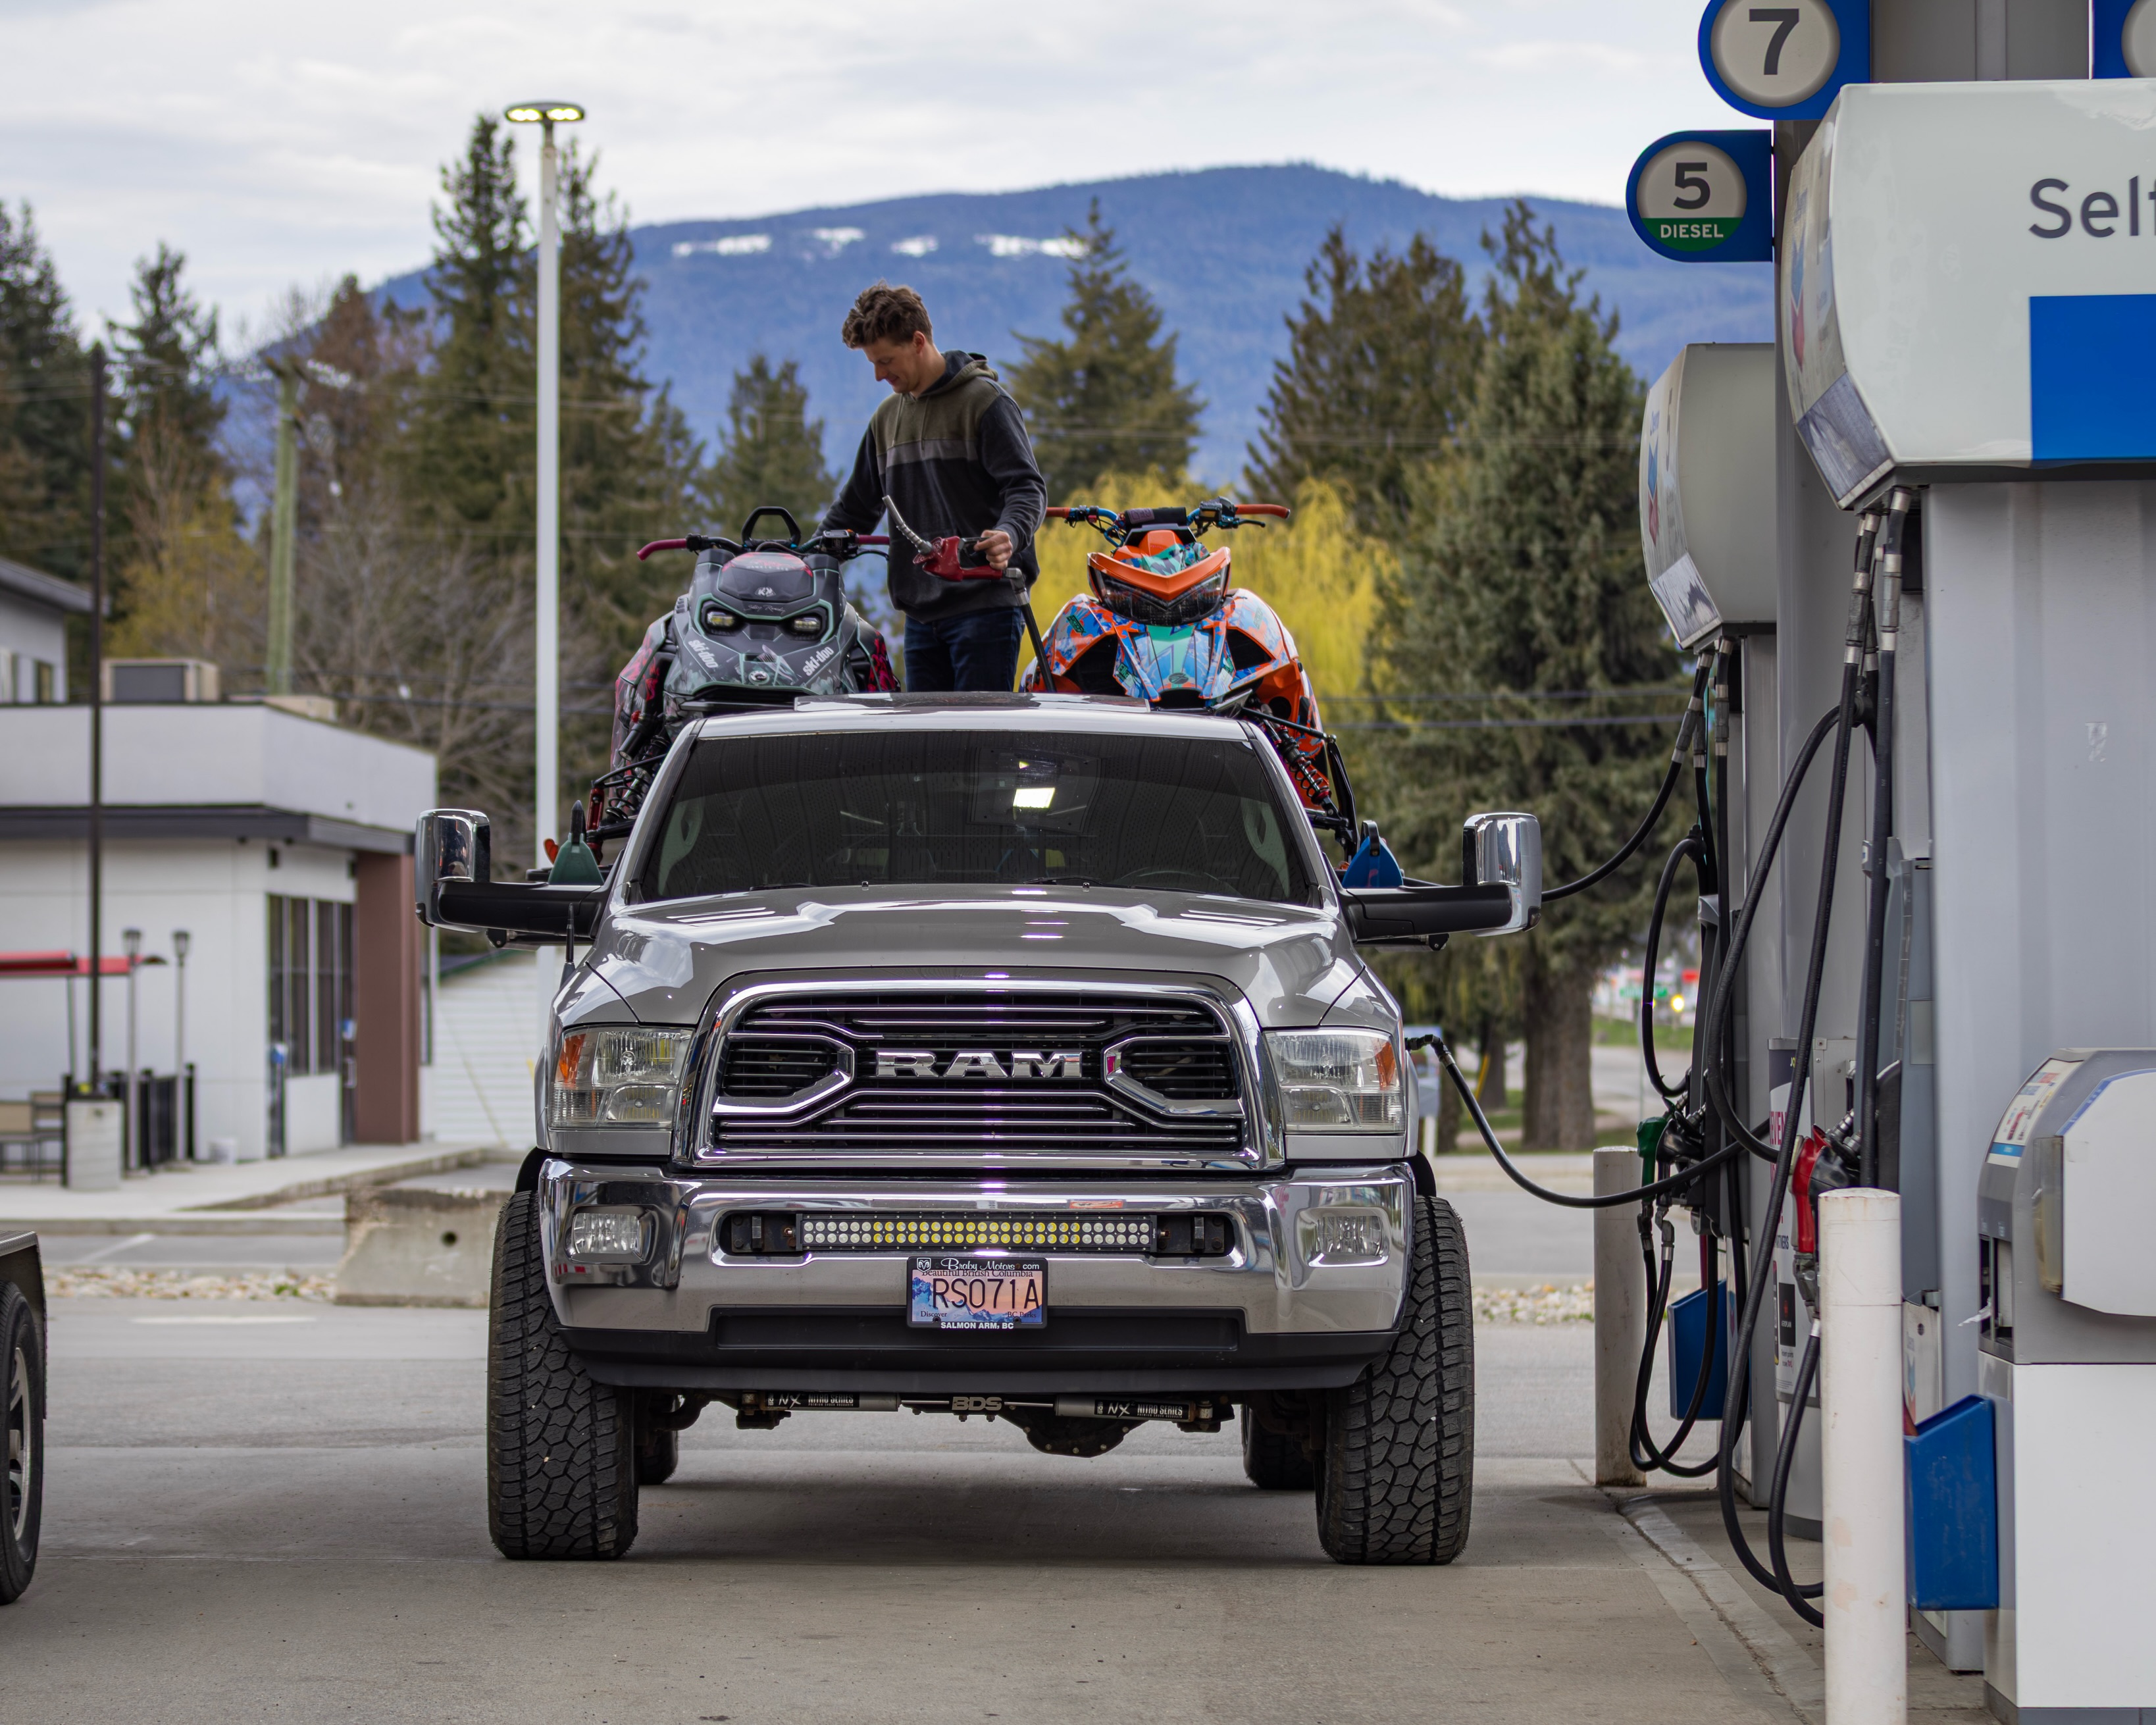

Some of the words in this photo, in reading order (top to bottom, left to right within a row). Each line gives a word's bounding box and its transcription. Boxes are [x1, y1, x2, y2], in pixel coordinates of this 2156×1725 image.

[1749, 9, 1799, 75] 7
[1673, 162, 1710, 209] 5
[1660, 224, 1724, 238] DIESEL
[688, 639, 718, 669] ski-doo
[802, 646, 834, 677] ski-doo
[876, 1051, 1083, 1078] RAM
[940, 1258, 977, 1273] Braby
[980, 1260, 1015, 1270] Motors
[808, 1393, 829, 1403] NITRO
[831, 1394, 854, 1404] SERIES
[952, 1397, 1002, 1411] BDS
[1137, 1404, 1158, 1414] NITRO
[1160, 1404, 1183, 1416] SERIES
